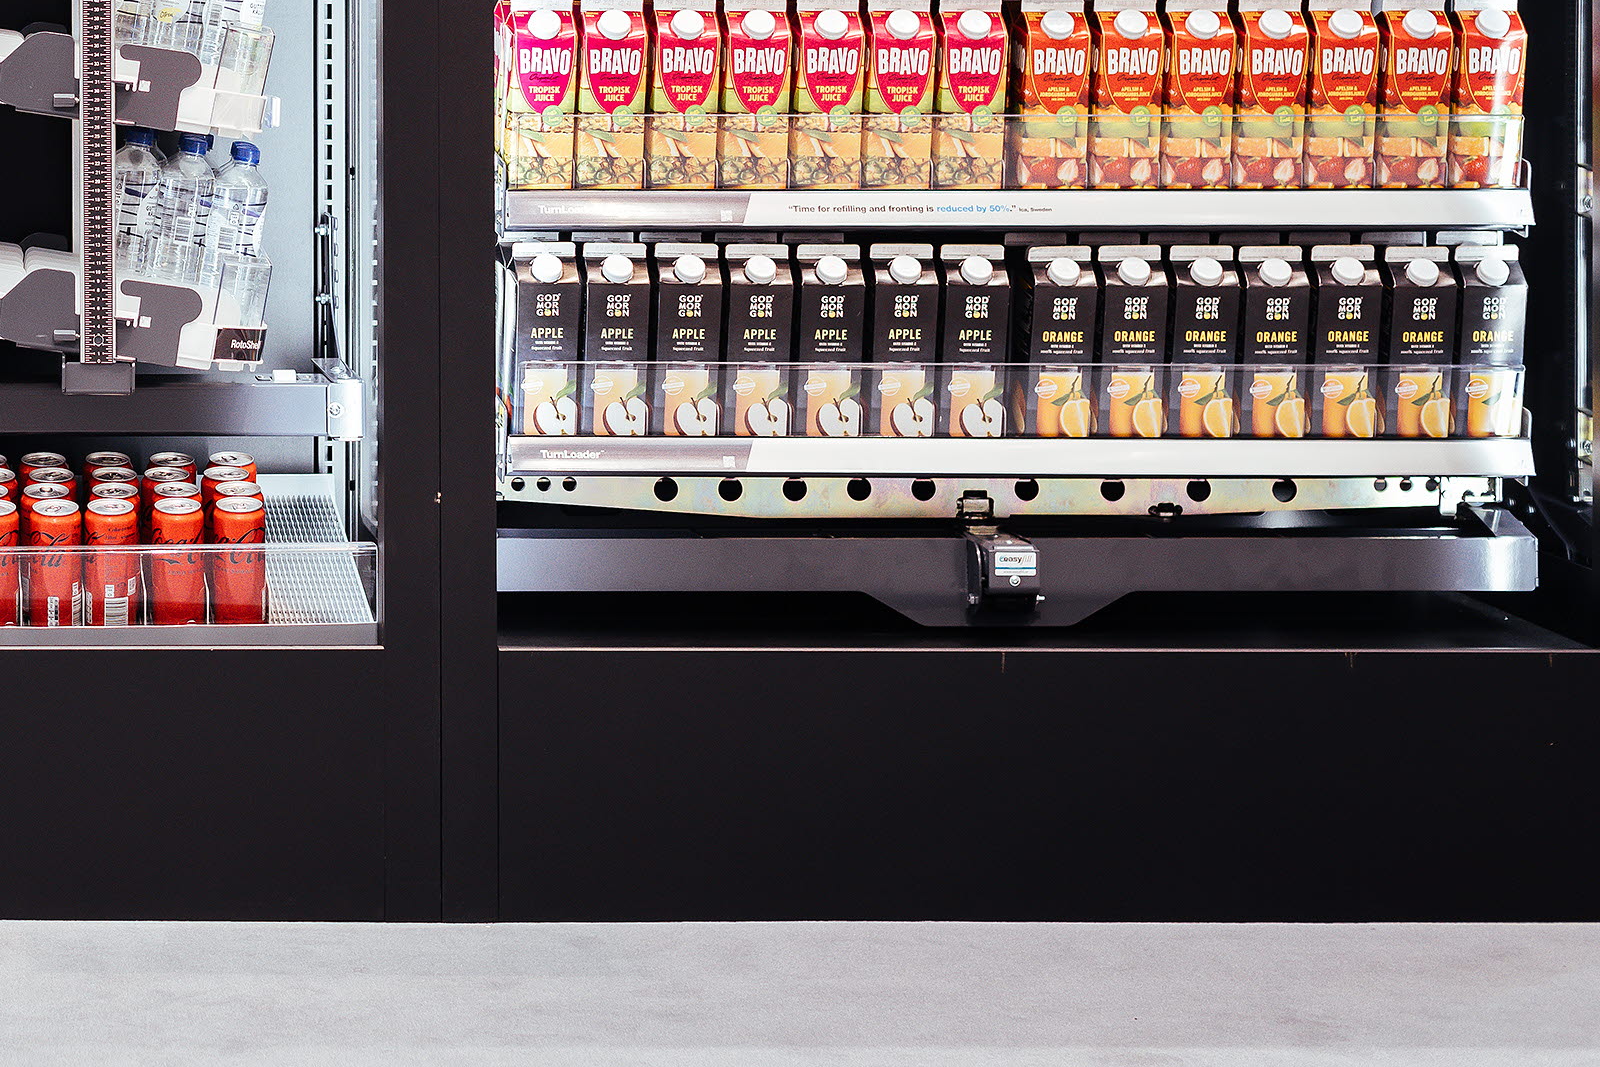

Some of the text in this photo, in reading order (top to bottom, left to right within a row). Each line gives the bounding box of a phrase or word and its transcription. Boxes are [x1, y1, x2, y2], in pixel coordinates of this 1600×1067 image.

[520, 47, 571, 75] BRAVO
[734, 47, 785, 75] BRAVO
[950, 47, 1001, 75] BRAVO
[1034, 47, 1085, 75] BRAVO
[1252, 47, 1304, 75] BRAVO
[1397, 48, 1448, 75] BRAVO
[528, 85, 560, 93] TROPISK
[743, 86, 774, 94] TROPISK
[958, 85, 990, 94] TROPISK
[533, 93, 555, 102] JUICE
[748, 93, 769, 102] JUICE
[963, 93, 984, 102] JUICE
[818, 205, 830, 213] for
[833, 205, 867, 215] refilling
[869, 205, 886, 213] and
[888, 205, 924, 215] fronting
[926, 205, 934, 213] is
[936, 205, 974, 213] reduced
[976, 205, 987, 215] by
[536, 293, 560, 303] GOD
[1053, 297, 1077, 306] GOD
[536, 302, 560, 310] MOR
[1053, 305, 1077, 313] MOR
[530, 327, 564, 339] APPLE
[743, 328, 777, 340] APPLE
[959, 329, 992, 341] APPLE
[1042, 330, 1083, 342] ORANGE
[1256, 331, 1297, 343] ORANGE
[1403, 331, 1444, 343] ORANGE
